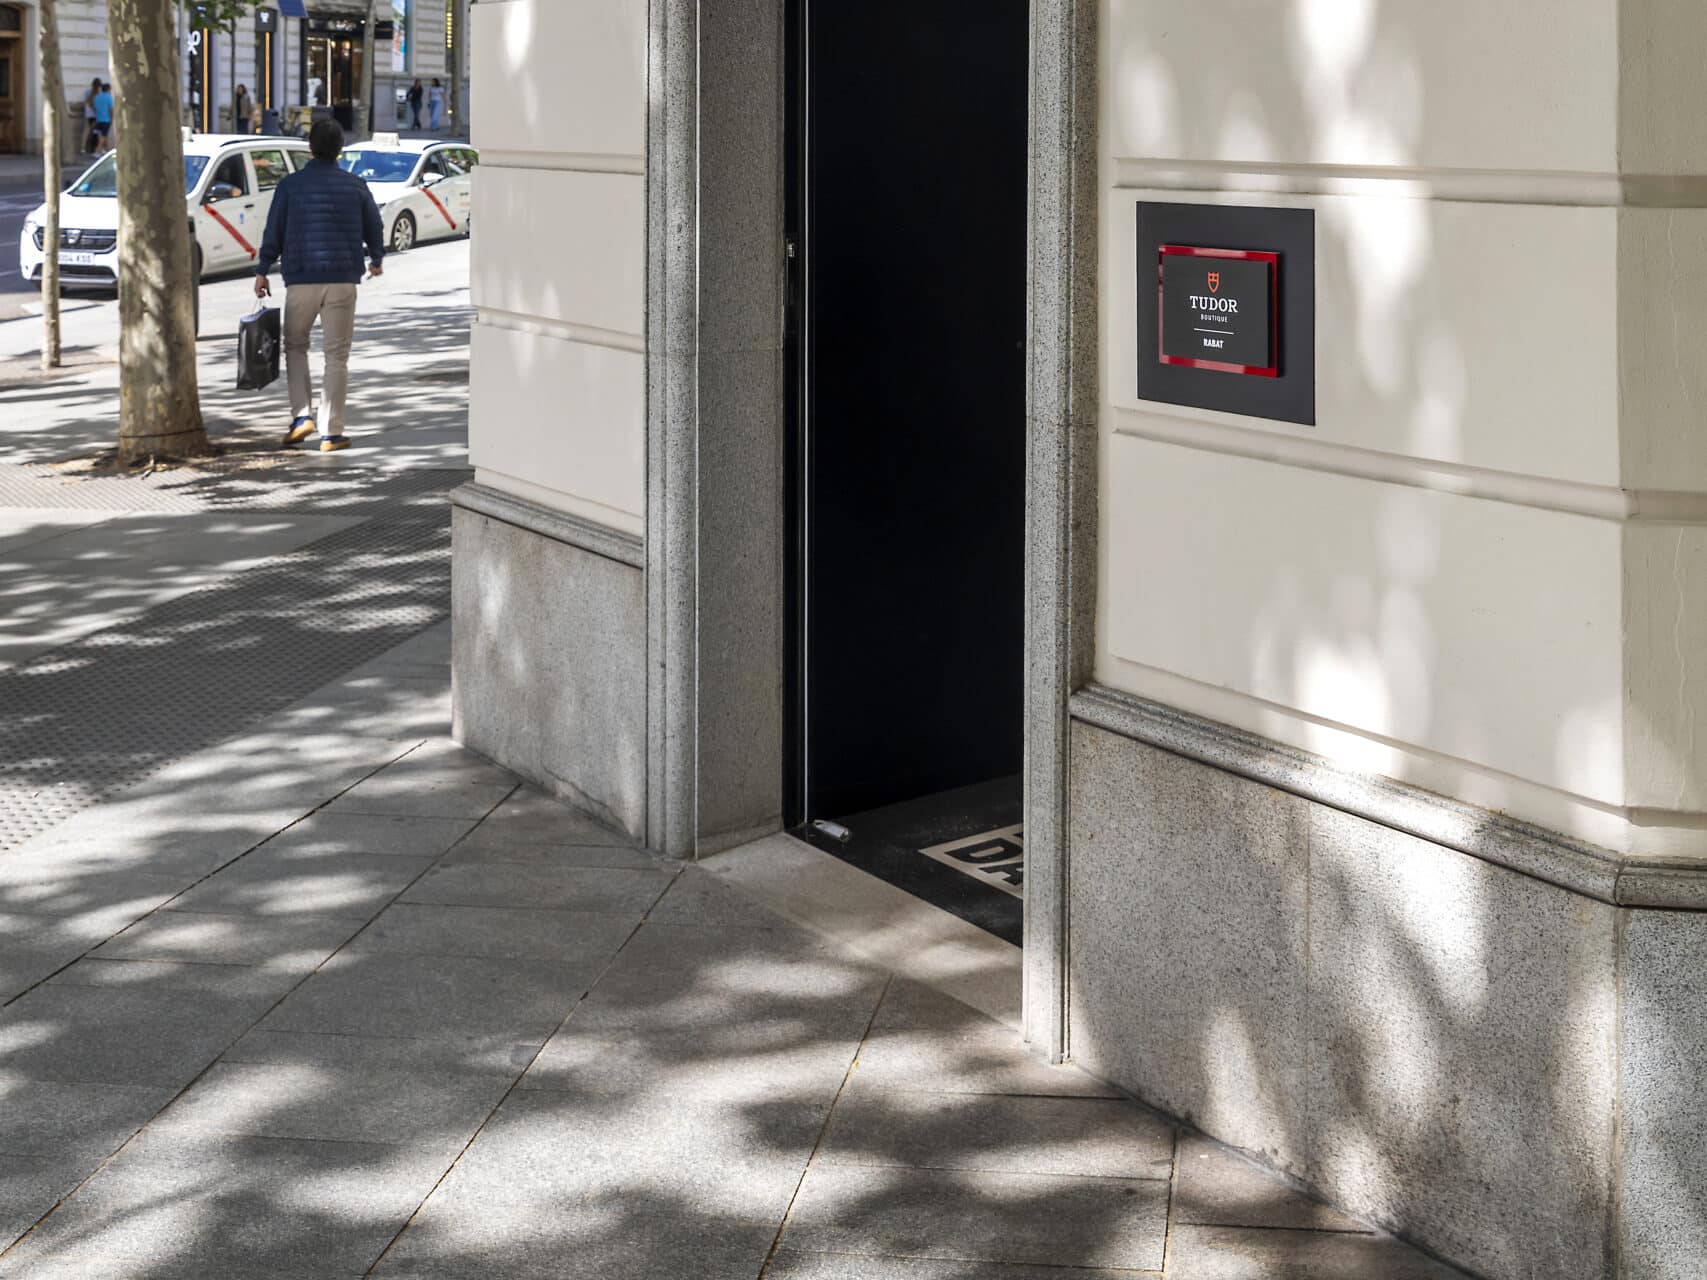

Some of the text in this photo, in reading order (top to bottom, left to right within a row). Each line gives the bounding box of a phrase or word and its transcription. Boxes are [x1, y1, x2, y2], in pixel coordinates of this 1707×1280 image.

[1189, 295, 1238, 312] TUDOR
[1200, 313, 1228, 322] BOUTIQUE
[1203, 338, 1224, 349] RABAT
